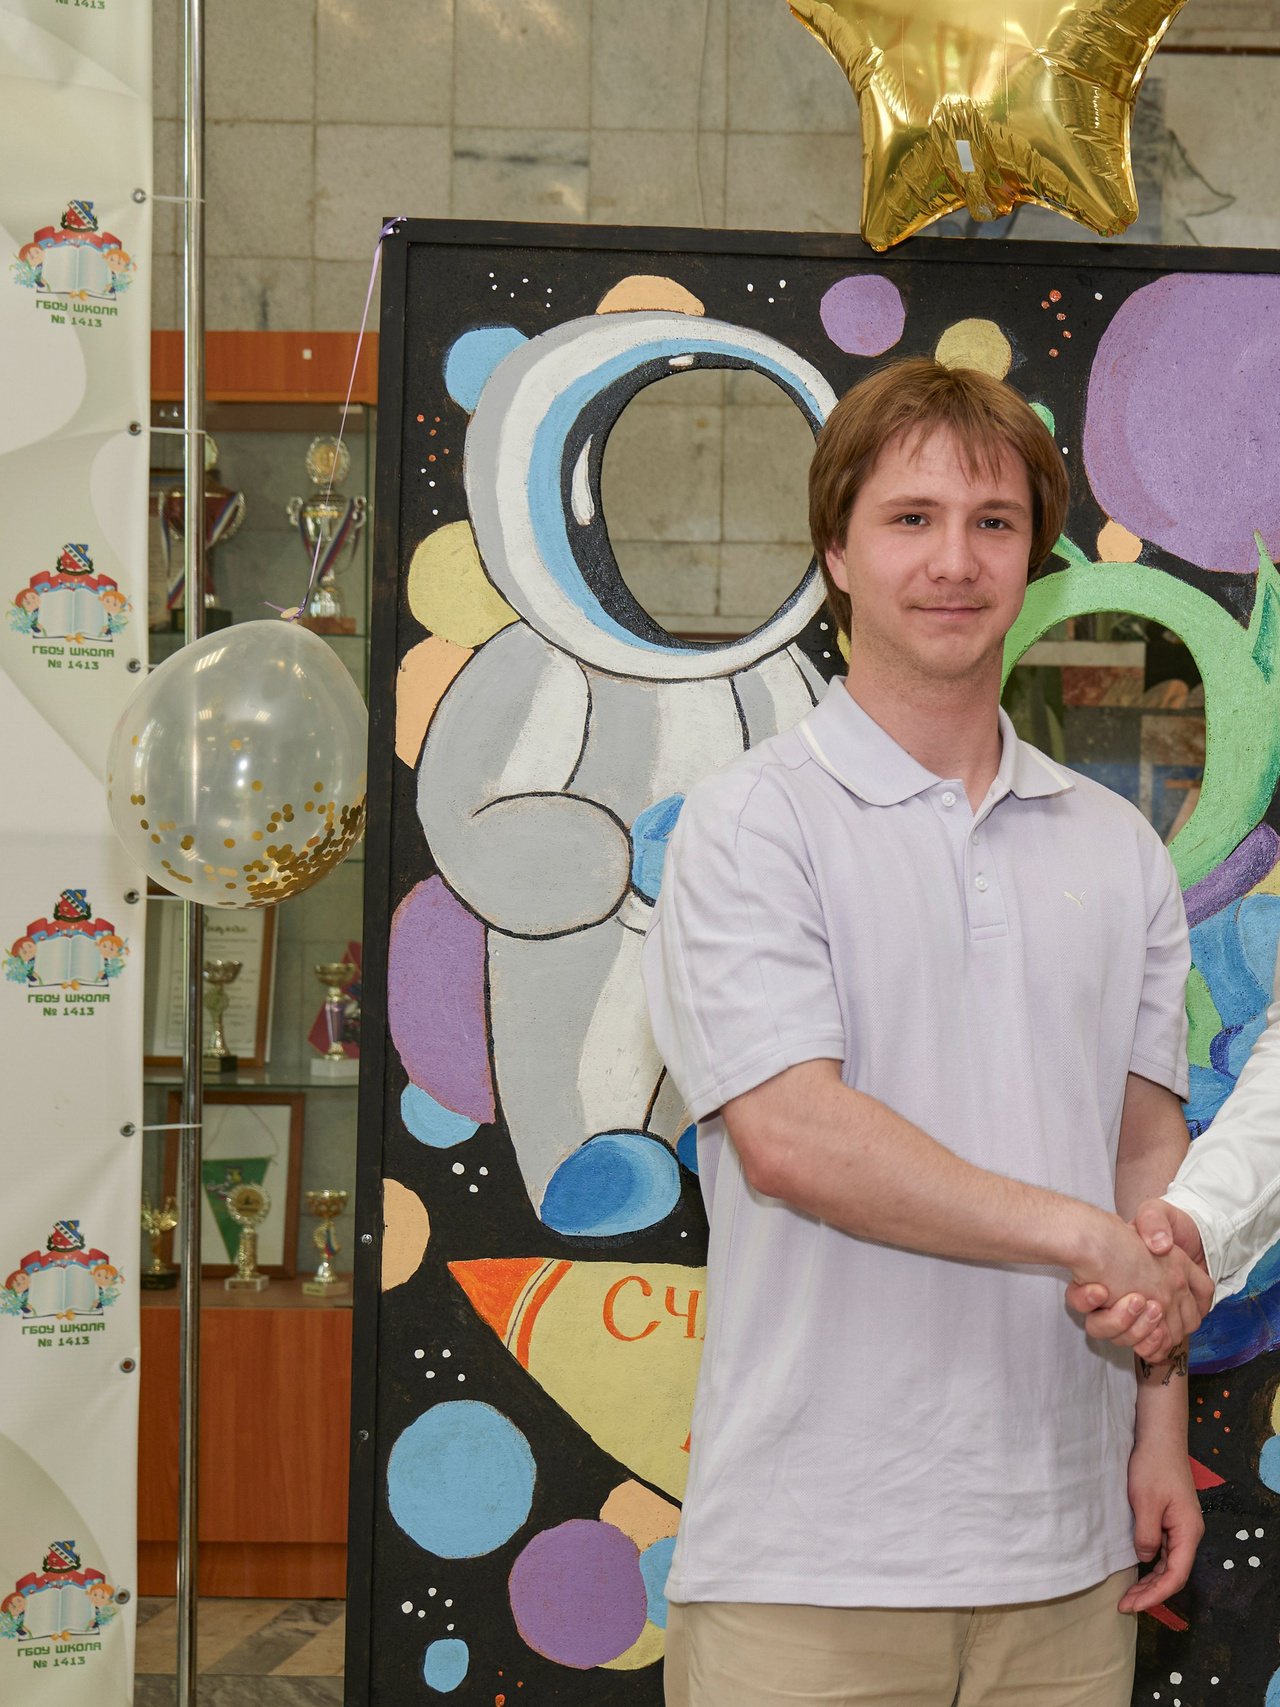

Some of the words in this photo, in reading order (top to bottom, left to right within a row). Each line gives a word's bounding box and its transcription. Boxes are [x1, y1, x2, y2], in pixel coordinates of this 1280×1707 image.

[36, 300, 68, 311] ГБОУ
[73, 303, 118, 316] ШКОЛА
[71, 317, 102, 328] 1413
[32, 645, 64, 655] ГБОУ
[69, 647, 114, 657] ШКОЛА
[68, 660, 99, 670] 1413
[27, 994, 60, 1003] ГБОУ
[65, 994, 110, 1003] ШКОЛА
[63, 1007, 94, 1016] 1413
[22, 1325, 55, 1335] ГБОУ
[60, 1322, 105, 1333] ШКОЛА
[58, 1336, 90, 1346] 1413
[17, 1646, 50, 1657] ГБОУ
[55, 1642, 101, 1654] ШКОЛА
[53, 1656, 85, 1667] 1413
